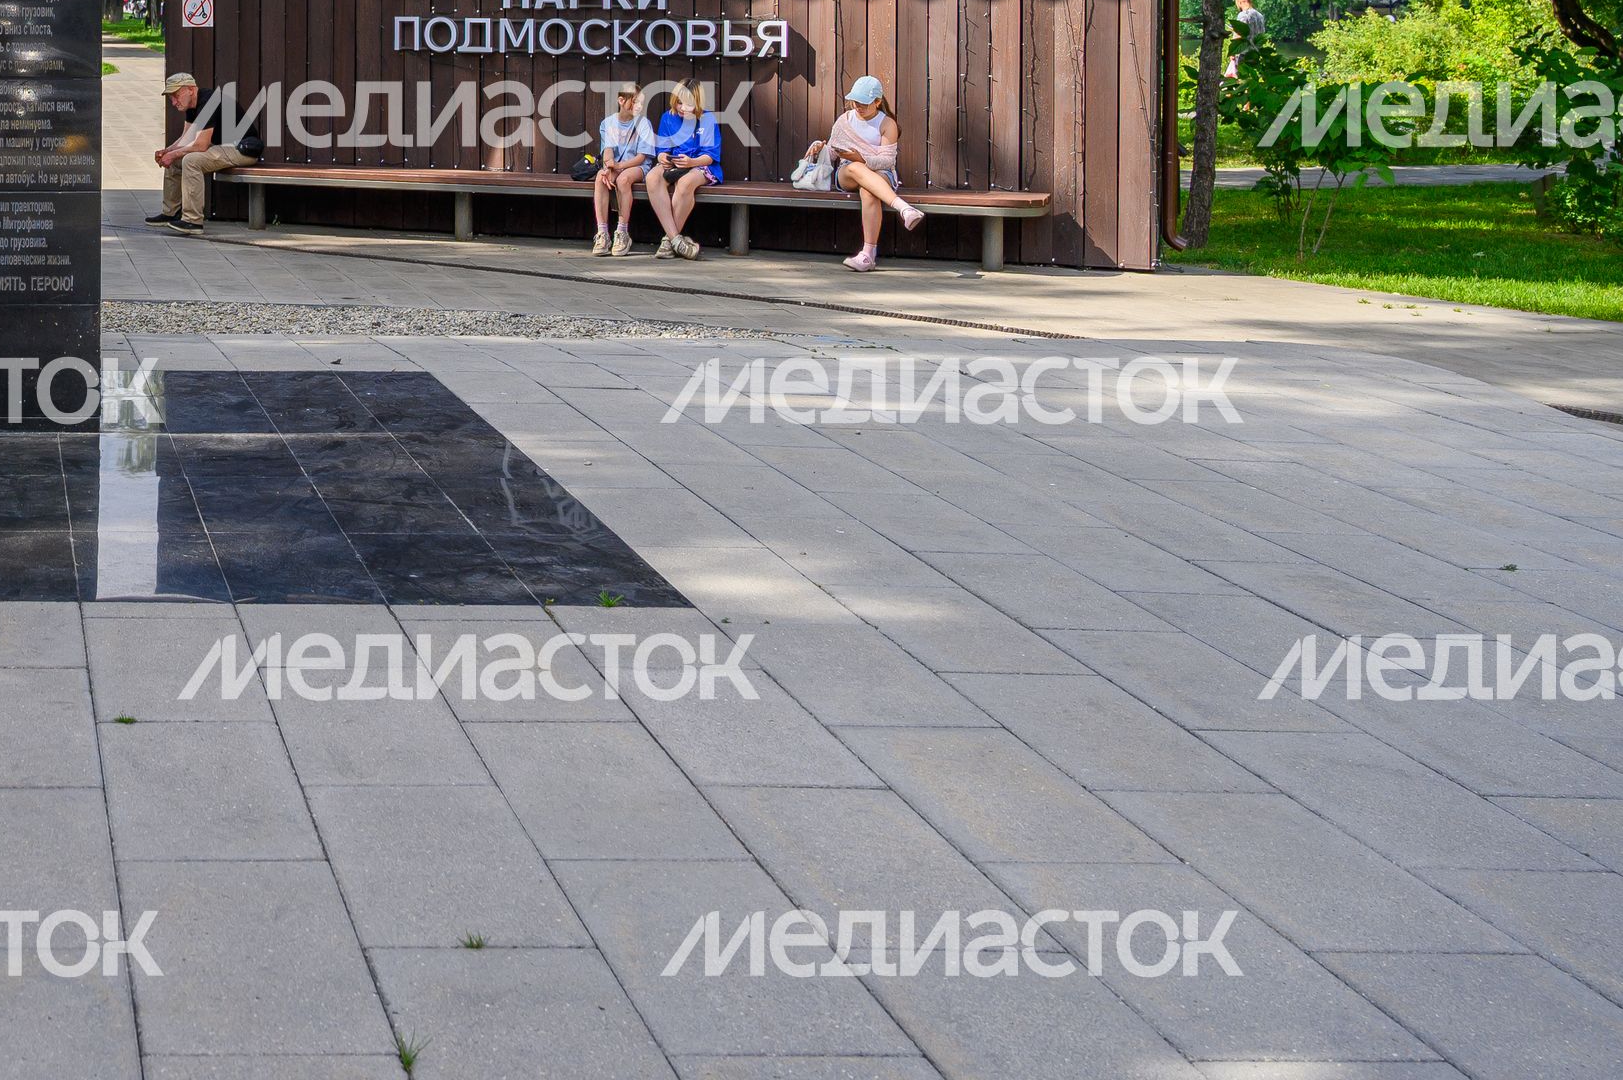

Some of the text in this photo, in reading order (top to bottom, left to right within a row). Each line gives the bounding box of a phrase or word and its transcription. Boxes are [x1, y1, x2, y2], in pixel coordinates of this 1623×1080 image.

[393, 15, 788, 58] ПОДМОСКОВЬЯ
[5, 42, 11, 52] с
[5, 136, 34, 150] машину
[35, 136, 40, 151] у
[38, 170, 48, 183] Но
[49, 173, 58, 183] не
[2, 216, 54, 233] Митрофанова
[0, 237, 9, 249] до
[30, 274, 74, 292] ГЕРОЮ!
